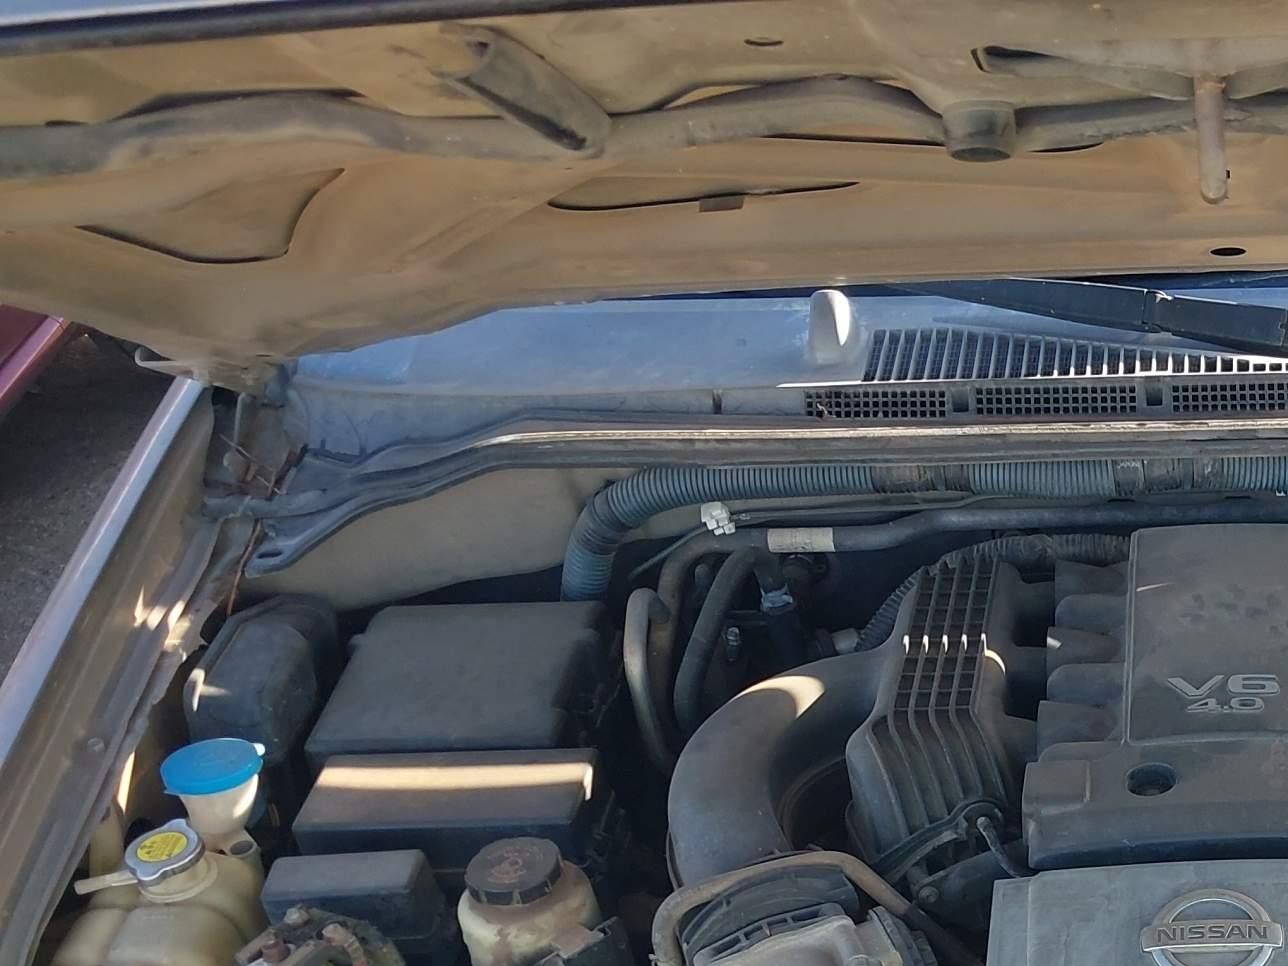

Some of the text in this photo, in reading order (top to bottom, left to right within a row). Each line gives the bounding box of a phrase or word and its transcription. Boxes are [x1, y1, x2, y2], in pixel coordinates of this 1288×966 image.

[1168, 674, 1281, 699] V6
[1186, 696, 1265, 713] 4.0
[1157, 925, 1268, 943] NISSAN
